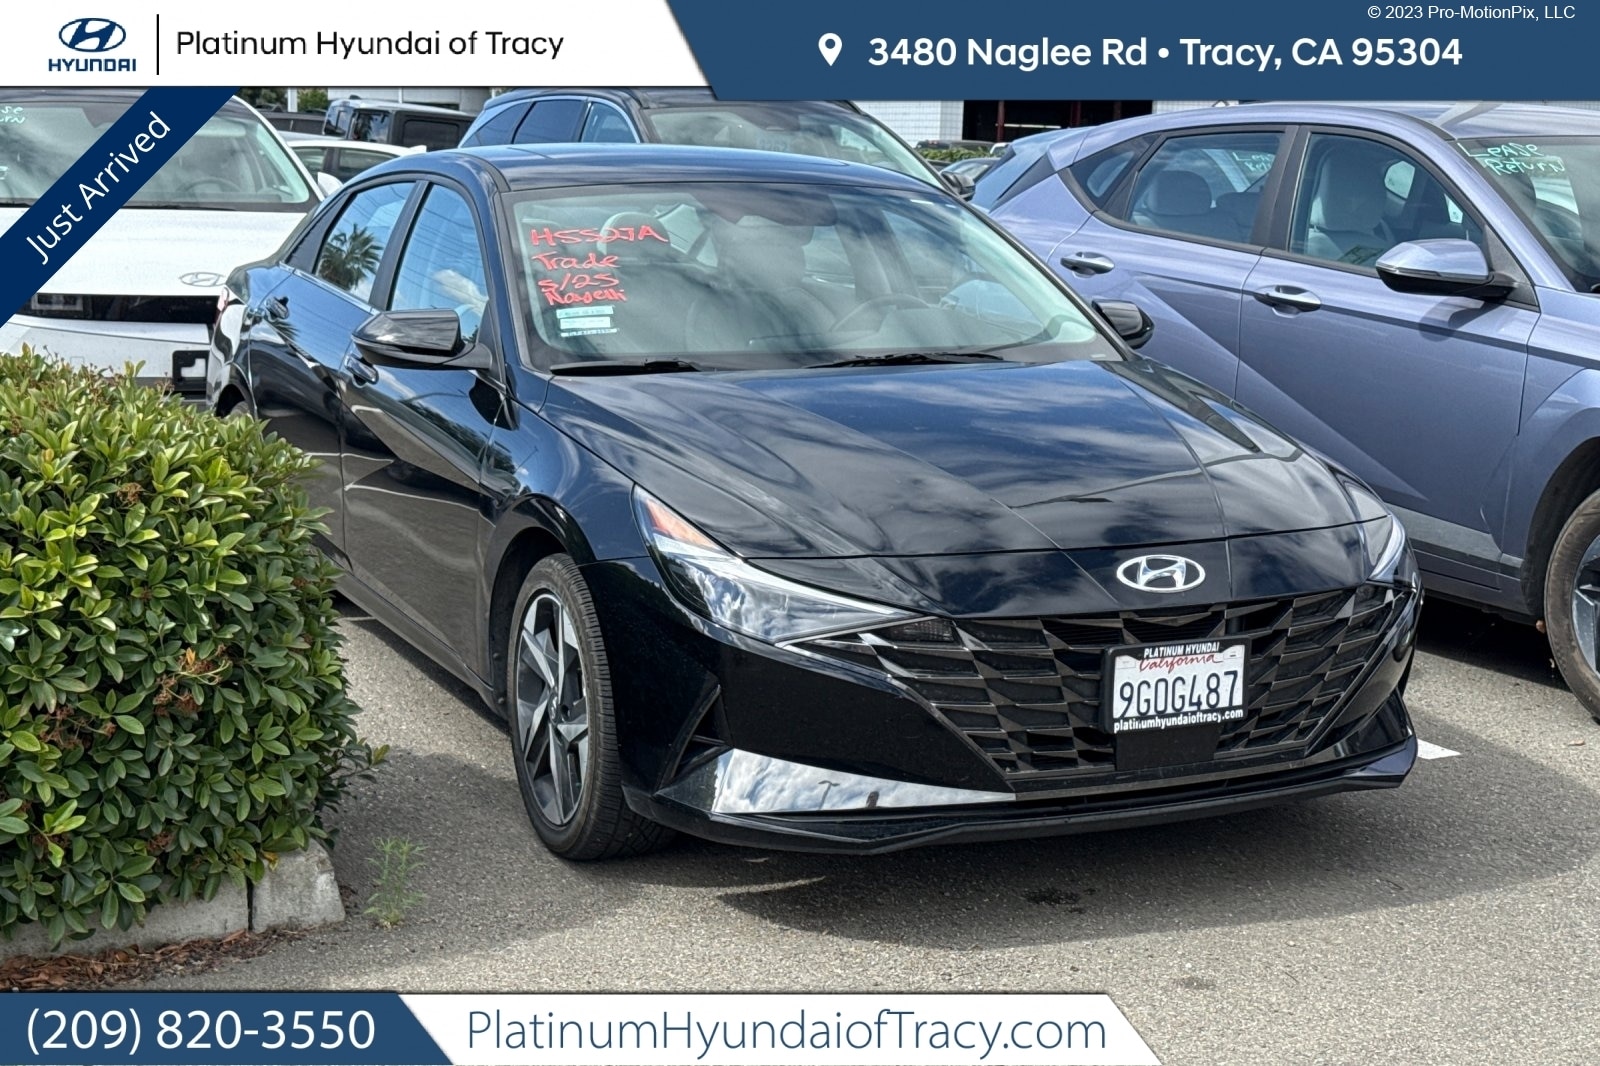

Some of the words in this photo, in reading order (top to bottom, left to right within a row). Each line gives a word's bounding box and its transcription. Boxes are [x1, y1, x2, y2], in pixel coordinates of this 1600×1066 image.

[531, 251, 622, 270] Trade
[1143, 644, 1184, 659] PLATINUM
[1185, 641, 1220, 655] HYUNDAI
[1139, 653, 1224, 674] California
[1113, 708, 1244, 734] platinumhyundaioftracy.com
